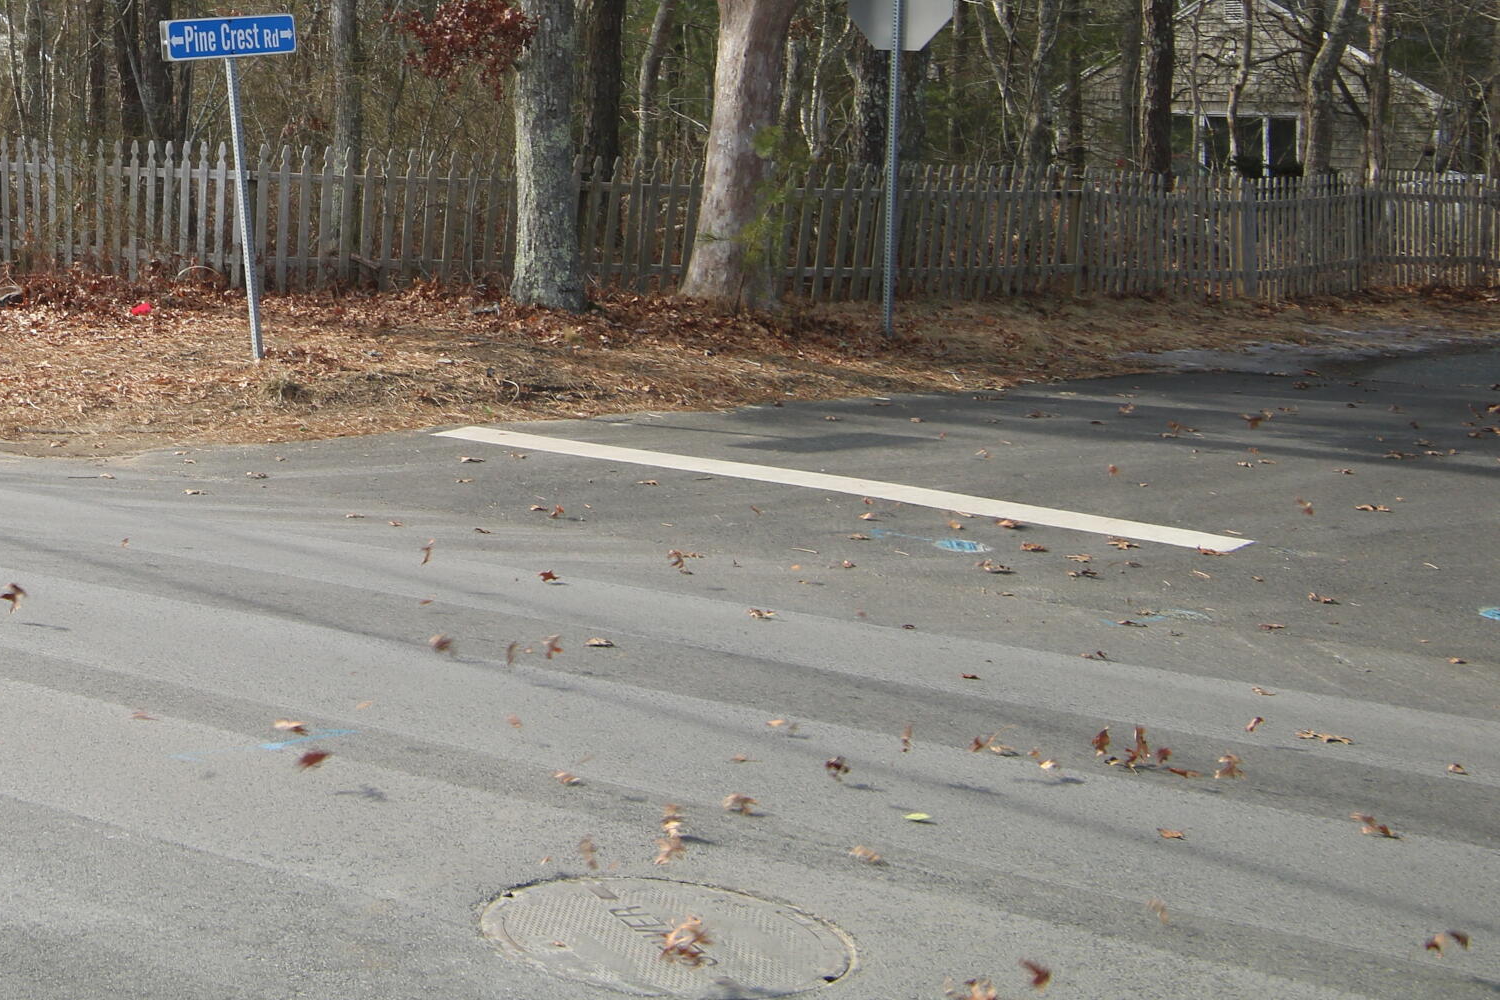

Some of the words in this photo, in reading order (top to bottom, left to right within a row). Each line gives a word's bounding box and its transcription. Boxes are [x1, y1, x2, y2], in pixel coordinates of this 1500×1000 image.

[184, 25, 216, 52] Pine
[220, 23, 261, 51] Crest
[263, 28, 280, 49] Rd
